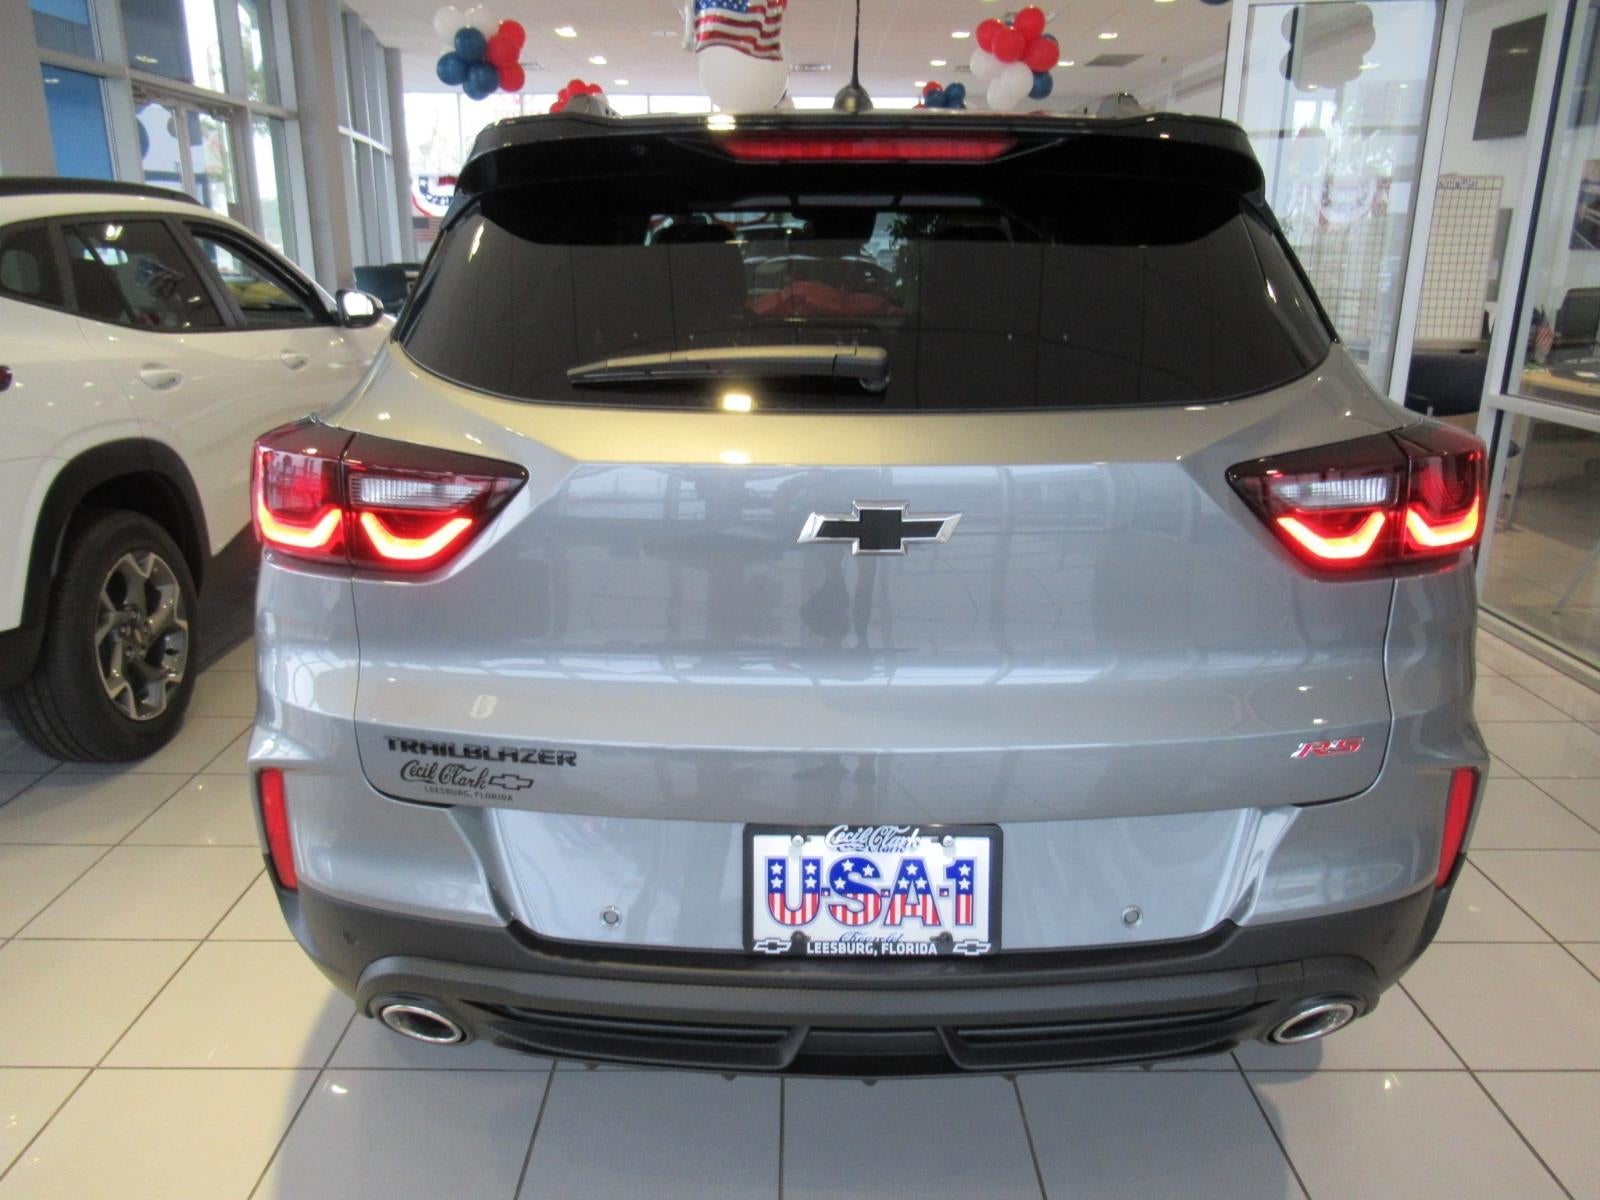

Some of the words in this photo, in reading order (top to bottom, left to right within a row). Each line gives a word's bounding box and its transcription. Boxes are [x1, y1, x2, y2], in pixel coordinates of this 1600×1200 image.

[385, 735, 578, 767] TRAILBLAZER
[1290, 736, 1365, 759] RS
[400, 759, 438, 784] Cecil
[438, 763, 490, 789] Clark
[475, 791, 513, 801] FLORIDA
[825, 825, 873, 851] Cecil
[869, 825, 921, 852] Clark
[806, 942, 877, 956] LEESBURG,
[881, 942, 938, 955] FLORIDA
